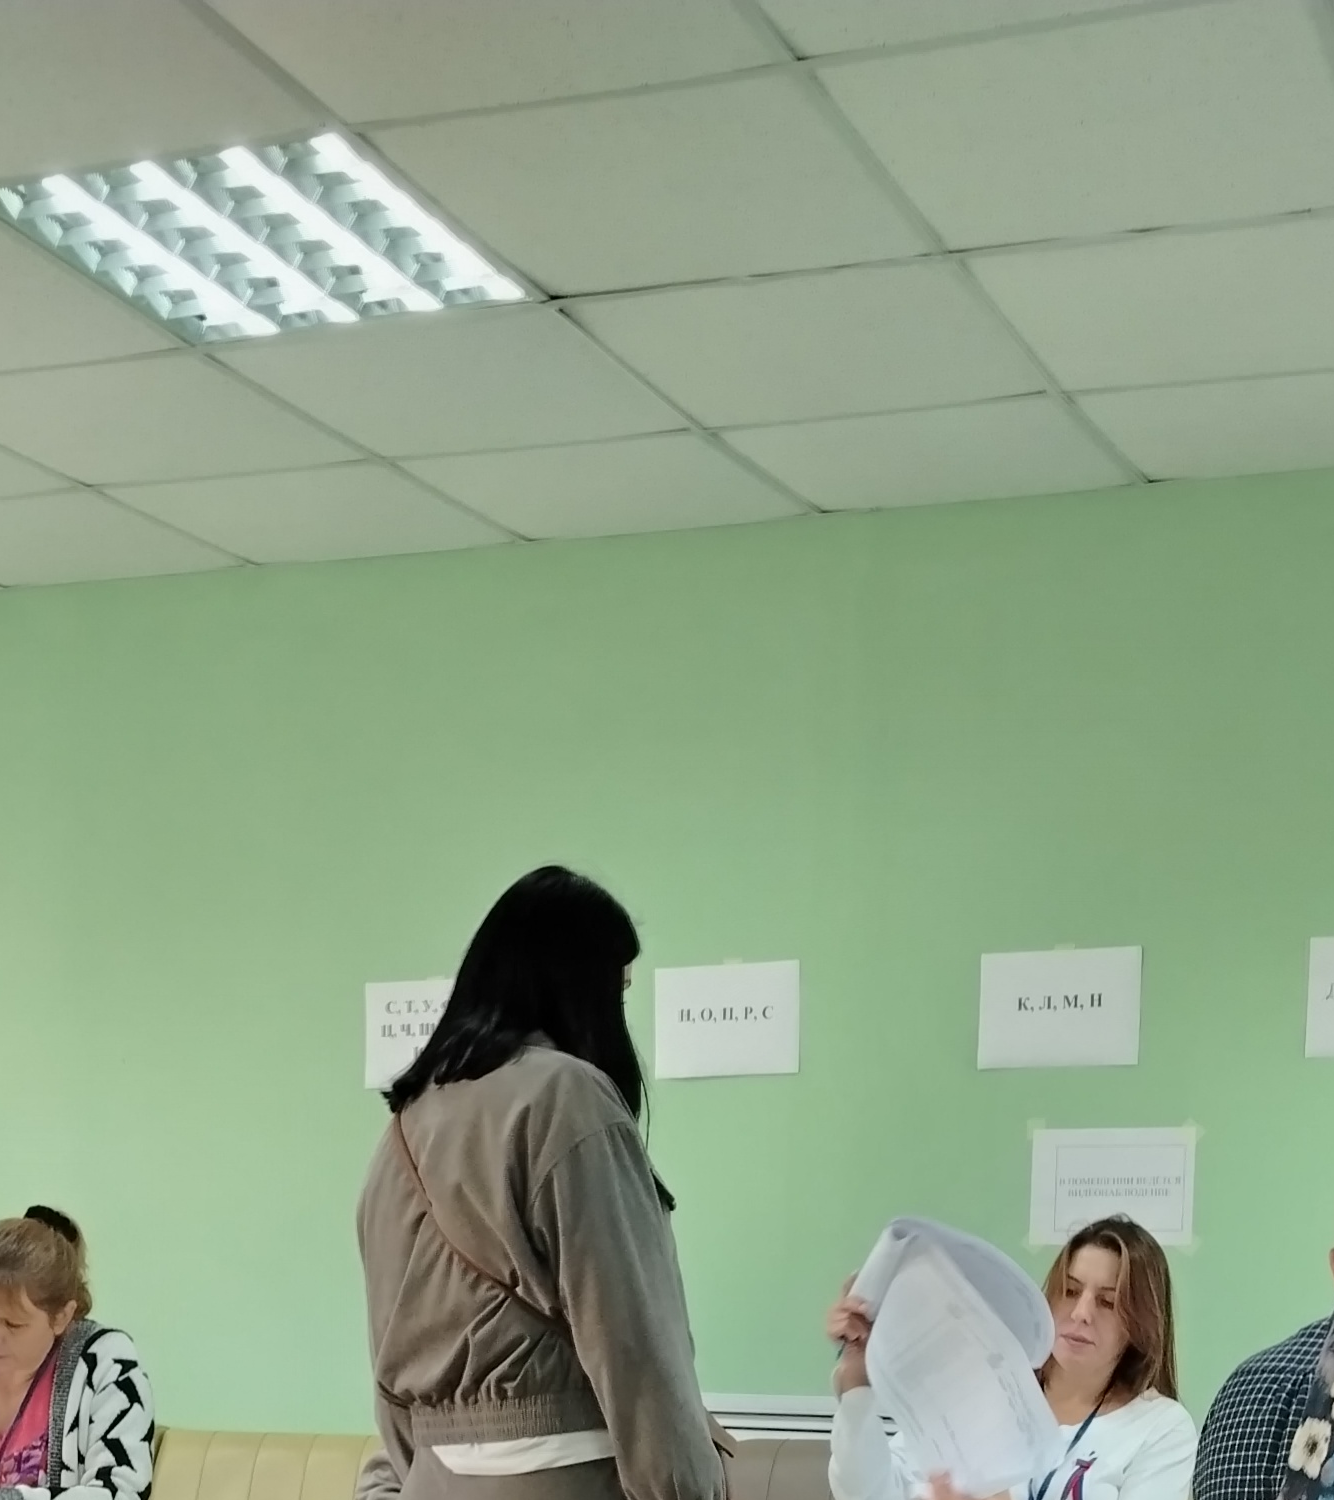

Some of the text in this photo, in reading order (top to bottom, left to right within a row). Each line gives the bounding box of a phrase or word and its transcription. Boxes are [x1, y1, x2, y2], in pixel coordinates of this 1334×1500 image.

[385, 1001, 402, 1015] С,
[404, 1000, 420, 1014] Т,
[422, 999, 438, 1013] У,
[1017, 992, 1103, 1013] К, Л, М, Н
[678, 1005, 774, 1023] Н, О, П, Р, С
[381, 1024, 398, 1038] Ц,
[400, 1023, 417, 1037] Ч,
